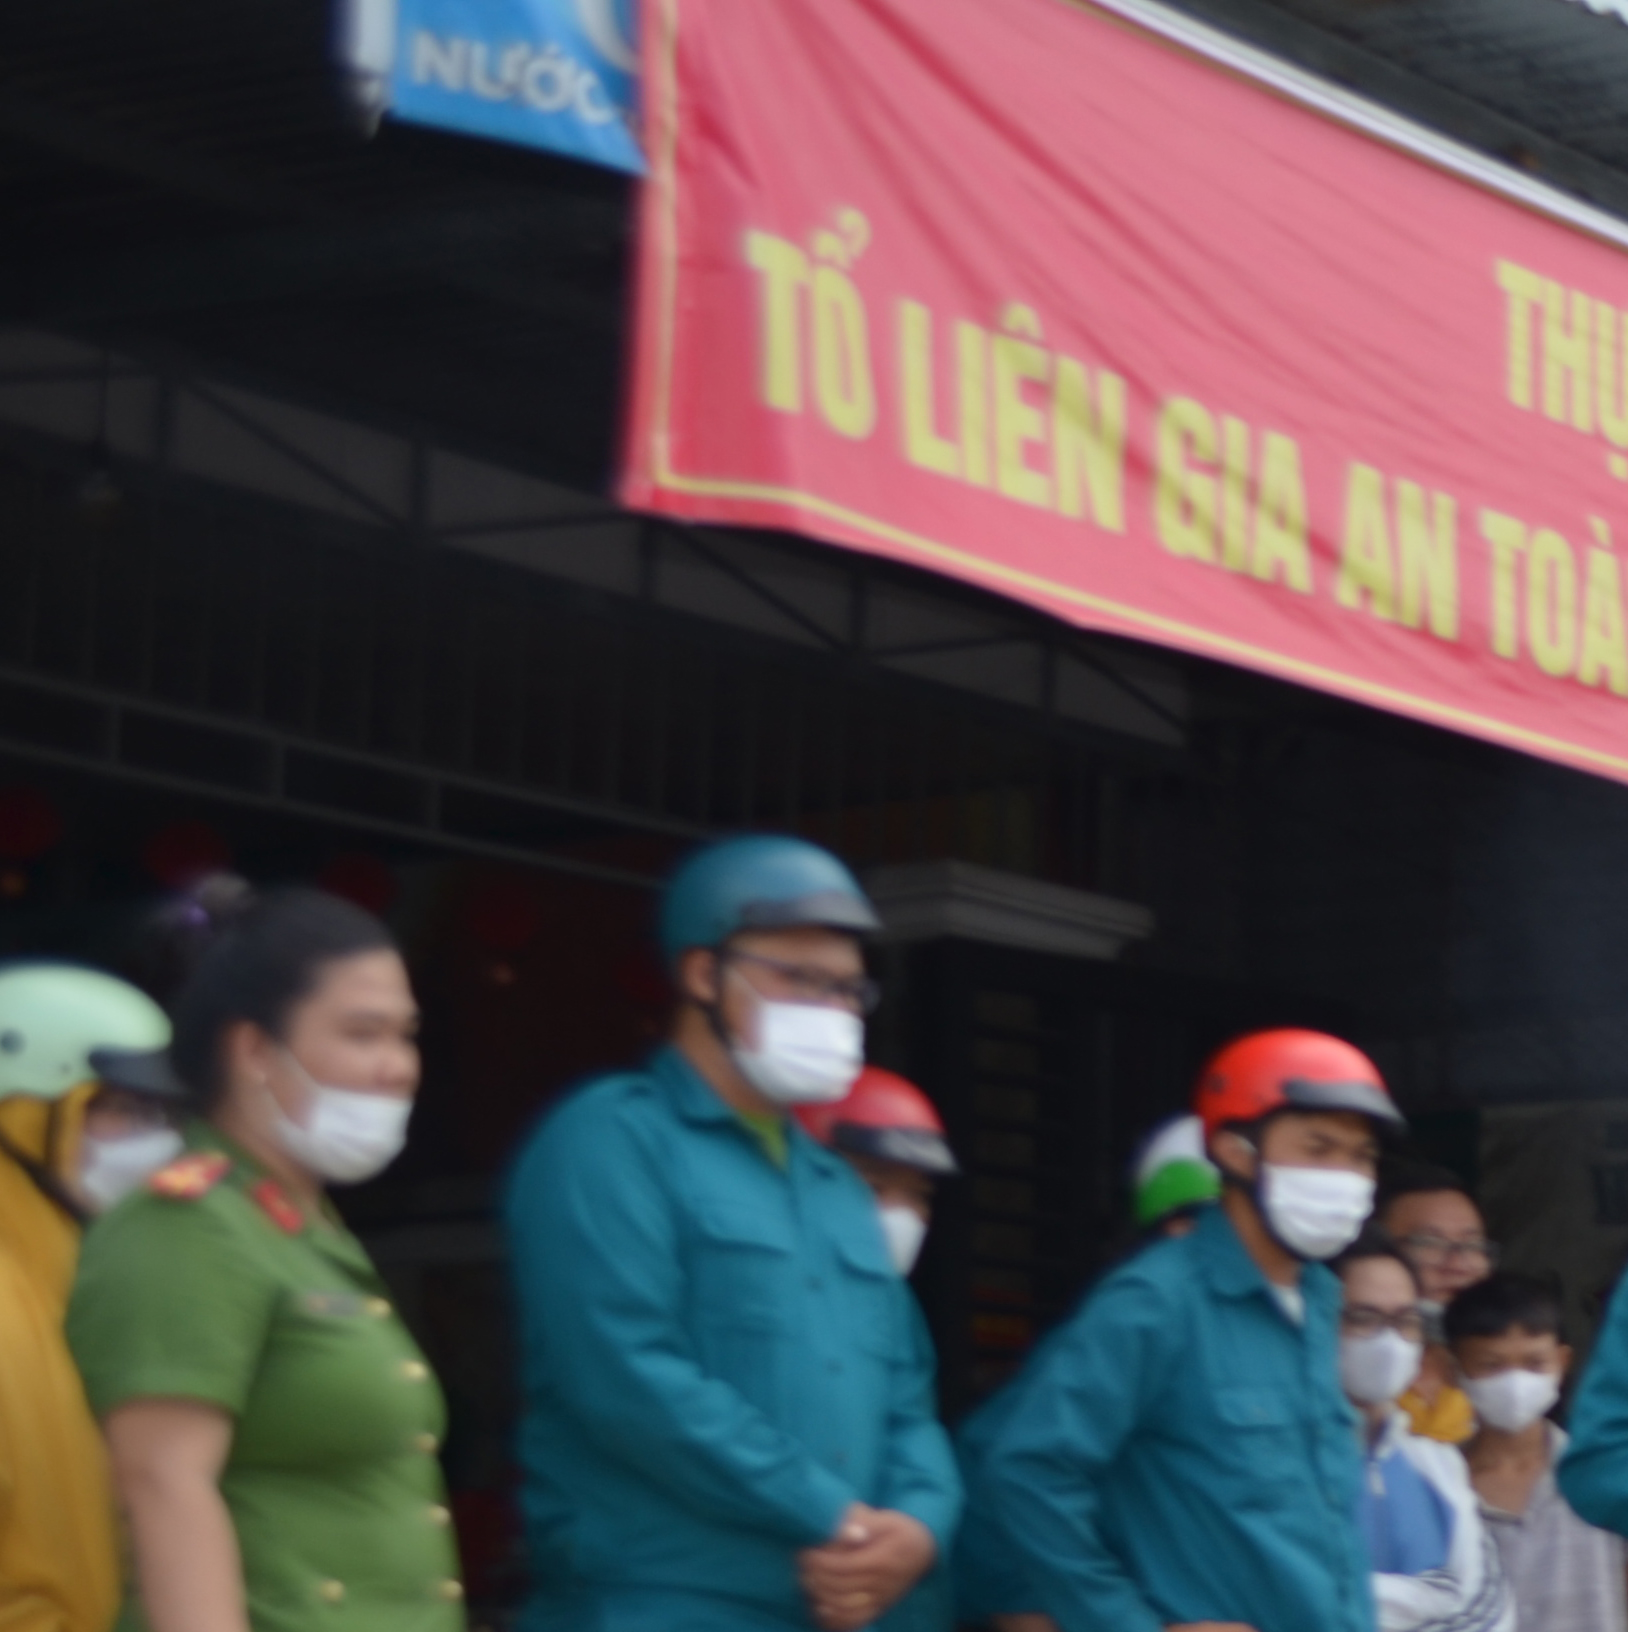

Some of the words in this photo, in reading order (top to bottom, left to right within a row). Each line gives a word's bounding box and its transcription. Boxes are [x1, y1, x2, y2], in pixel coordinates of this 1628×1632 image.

[743, 208, 876, 442] TỔ
[894, 302, 1128, 536] LIÊN
[1153, 394, 1314, 597] GIA
[1332, 459, 1460, 643] AN
